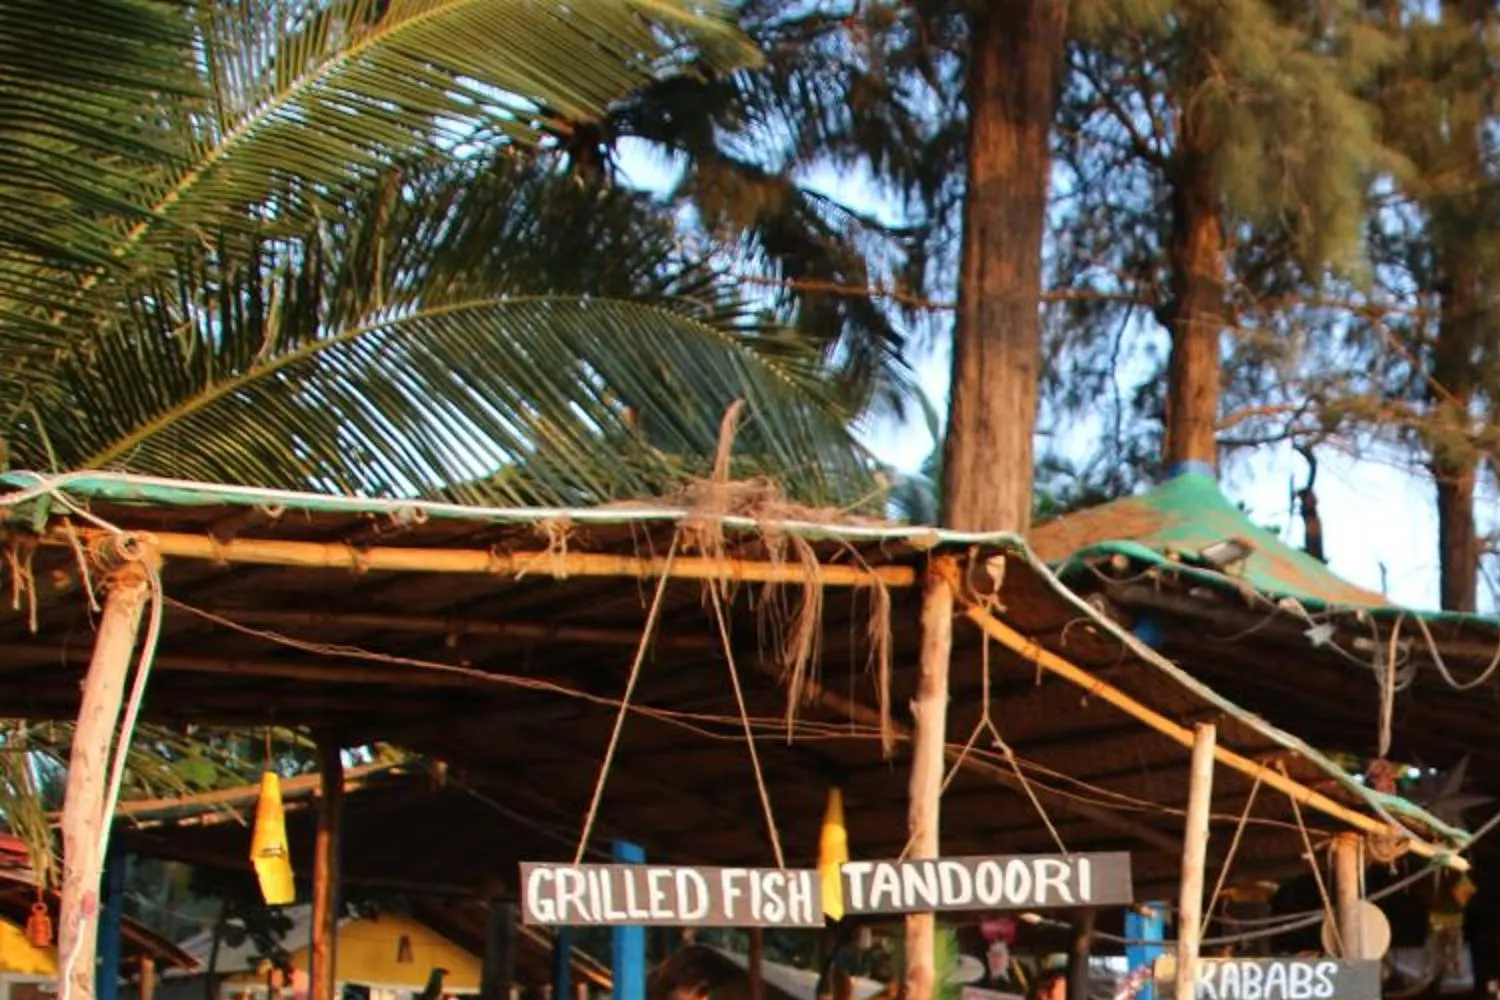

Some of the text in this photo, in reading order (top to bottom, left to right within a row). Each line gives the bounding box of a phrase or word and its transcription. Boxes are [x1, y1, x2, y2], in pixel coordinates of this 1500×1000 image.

[526, 861, 814, 923] GRILLED FISH
[842, 857, 1091, 911] TANDOORI
[1195, 961, 1339, 1000] KABABS
